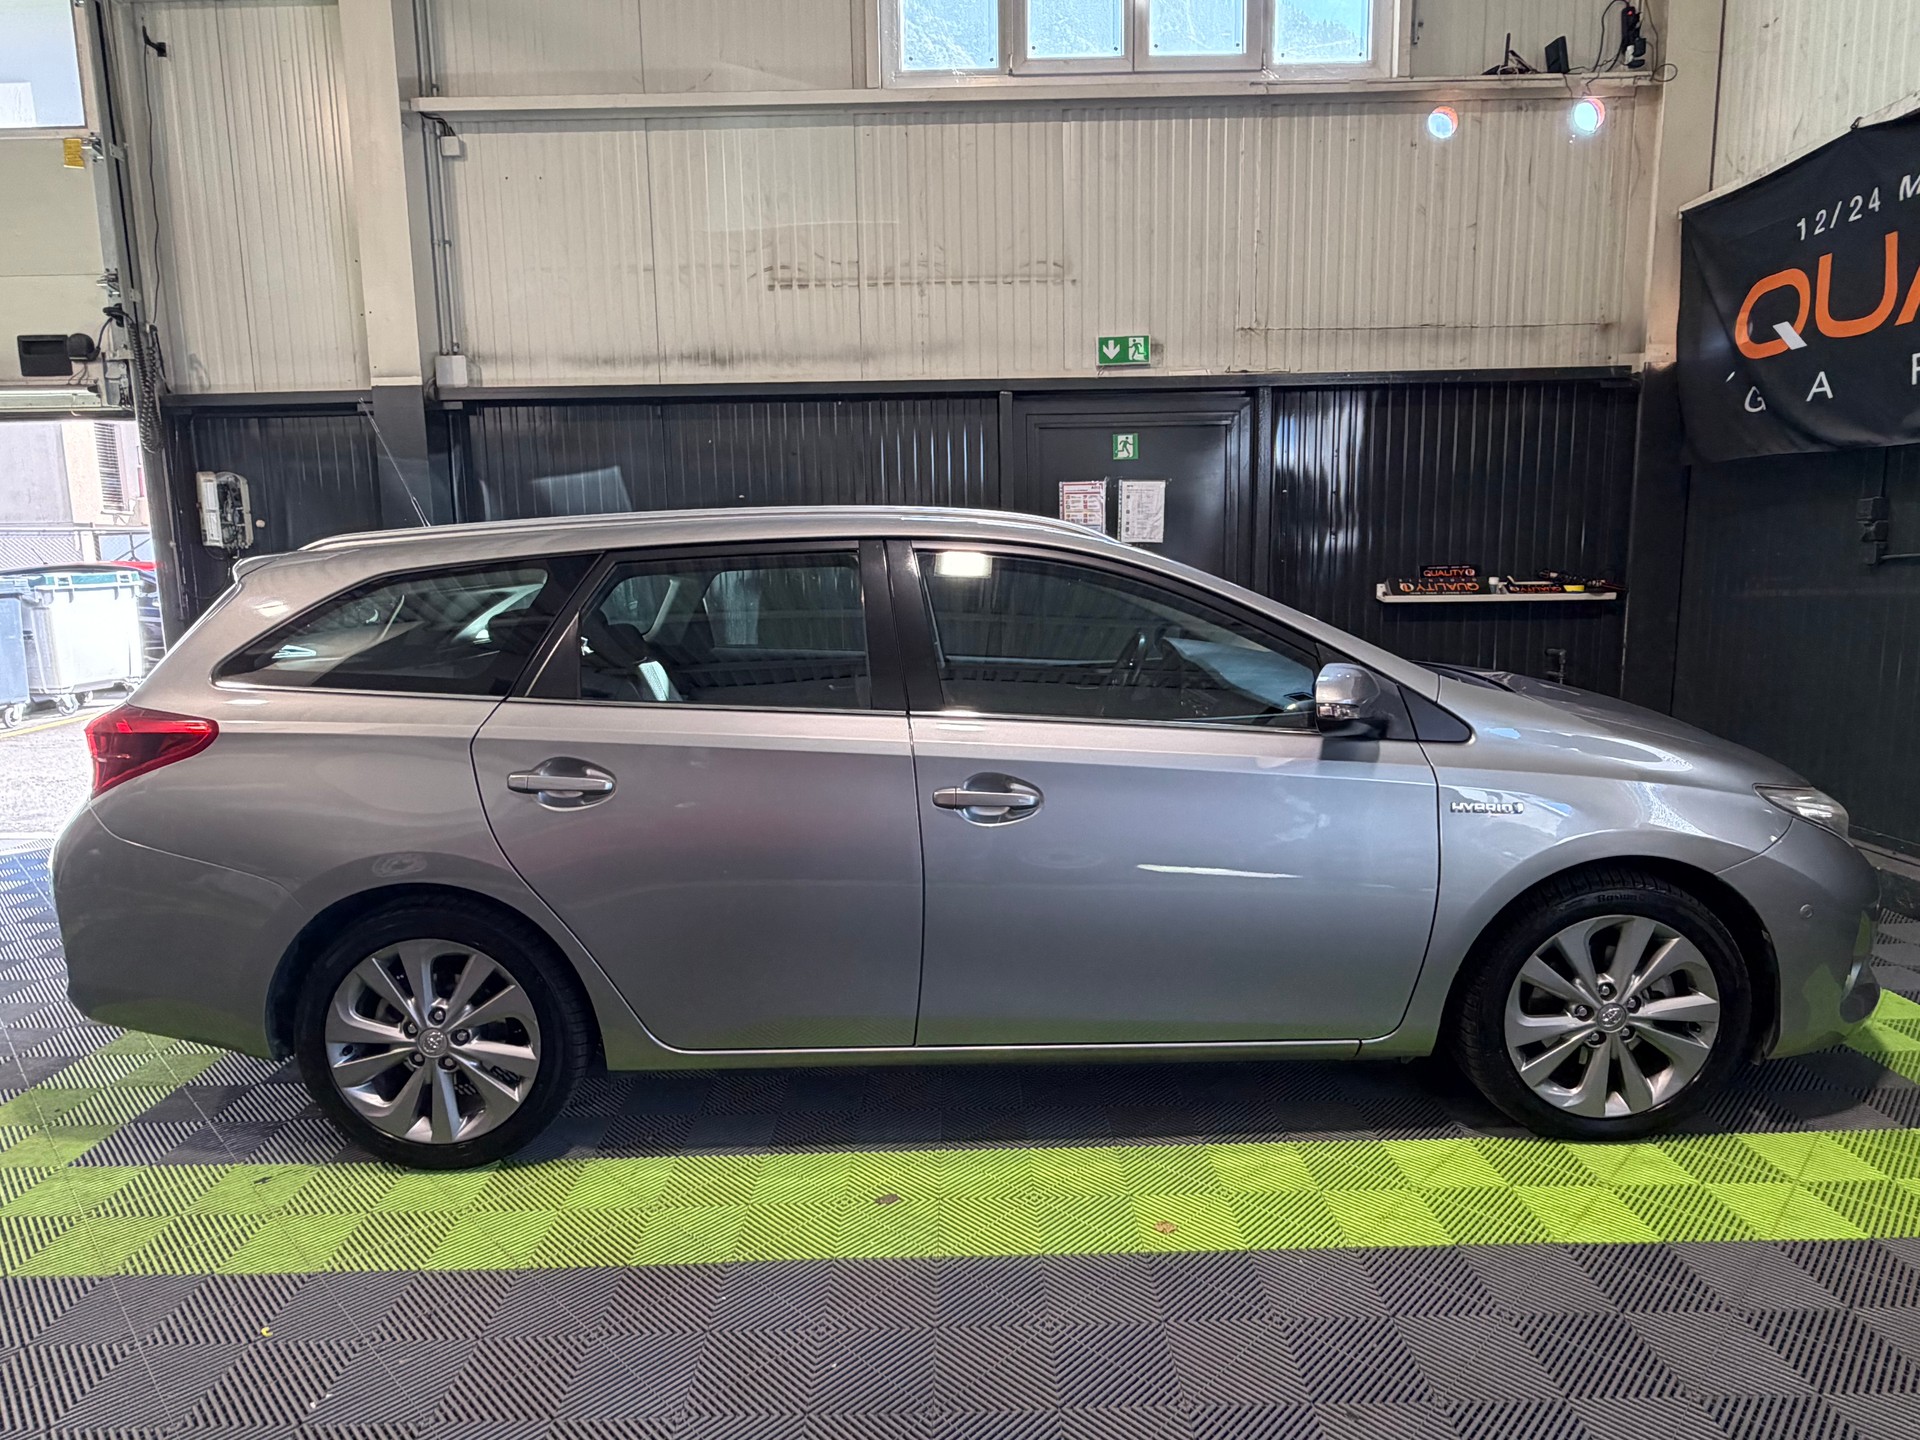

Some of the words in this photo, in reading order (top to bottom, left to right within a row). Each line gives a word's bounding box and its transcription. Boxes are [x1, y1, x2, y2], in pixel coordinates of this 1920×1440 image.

[1797, 187, 1882, 241] 12/24
[1423, 569, 1464, 577] QUALITY
[1416, 582, 1480, 591] QUALITY
[1450, 802, 1513, 814] HYBRID
